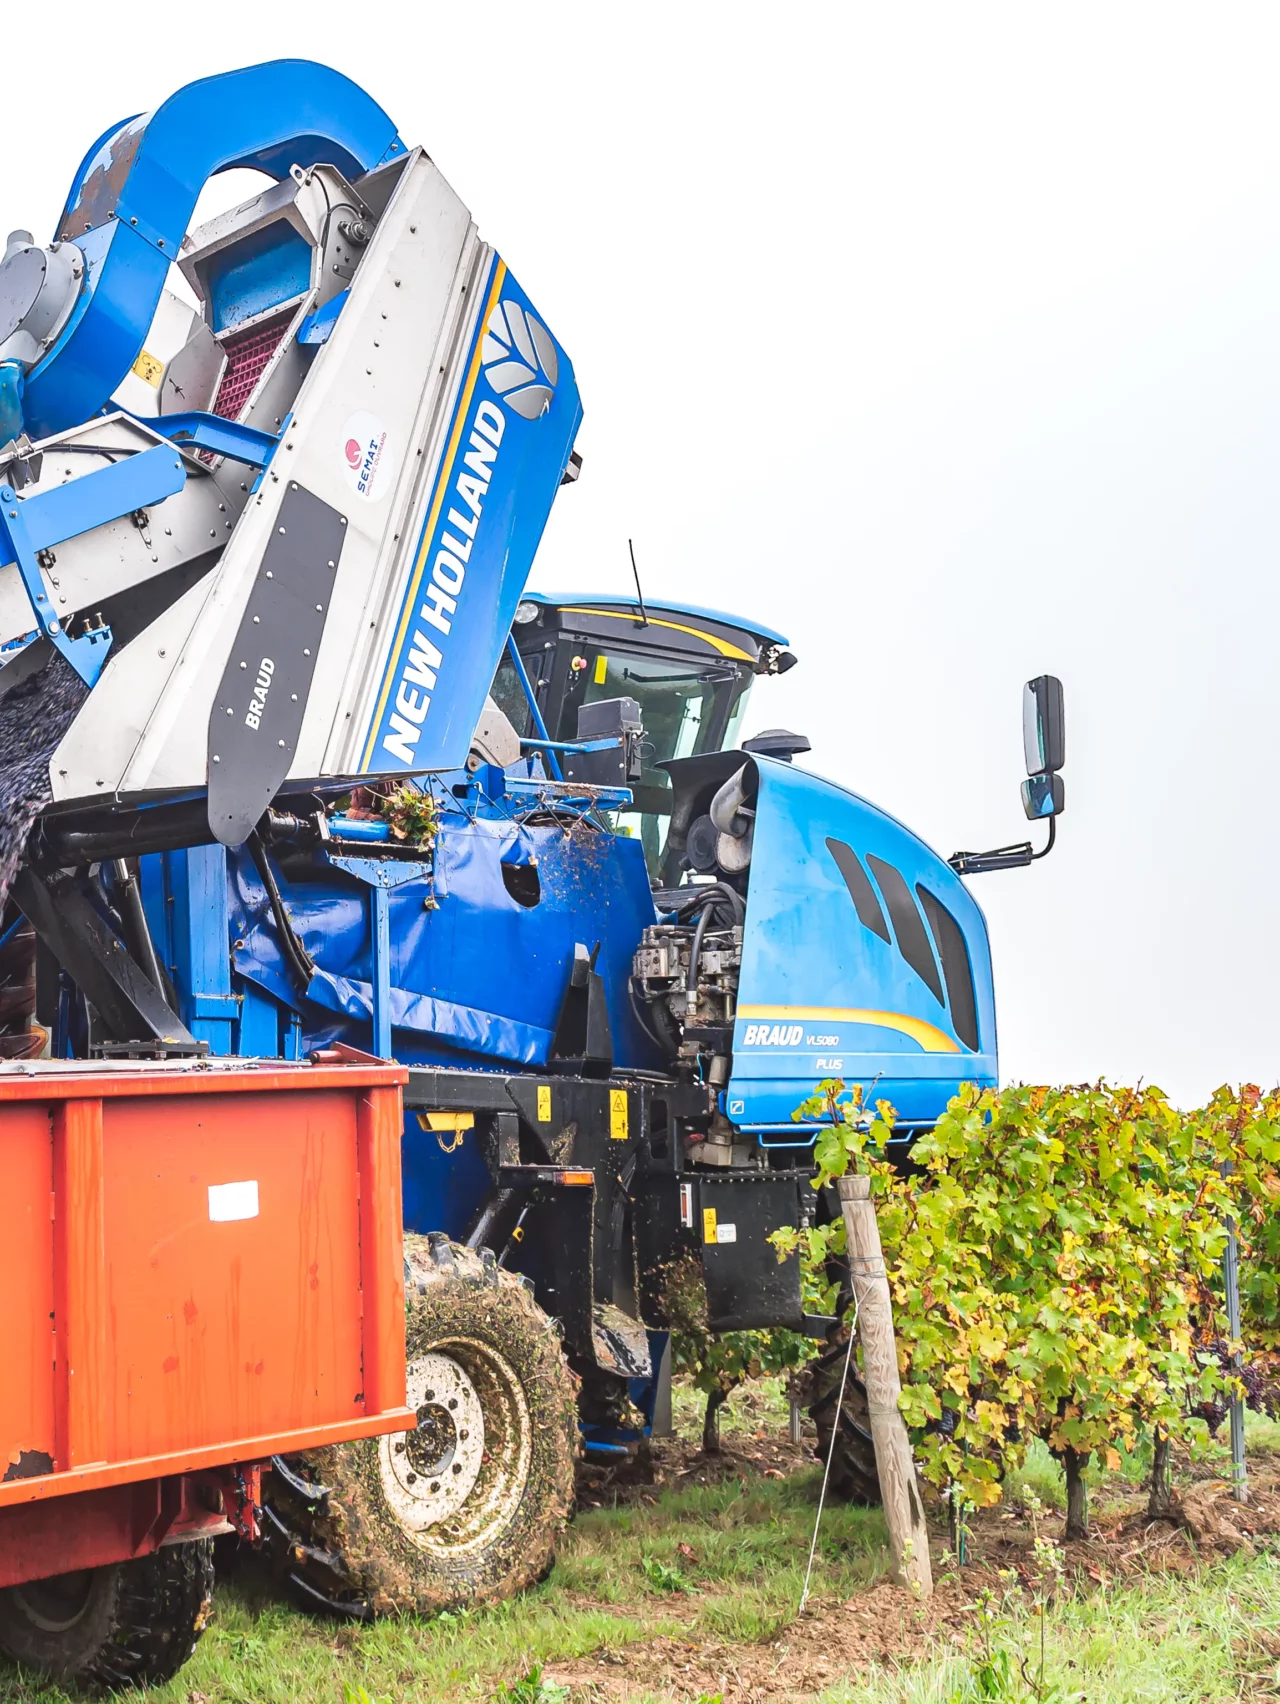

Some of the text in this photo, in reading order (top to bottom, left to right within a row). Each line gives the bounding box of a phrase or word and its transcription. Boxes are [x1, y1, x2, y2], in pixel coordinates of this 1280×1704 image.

[357, 439, 378, 493] SEMAT
[382, 399, 507, 766] NEW HOLLAND
[245, 657, 275, 731] BRAUD
[743, 1024, 804, 1046] BRAUD
[815, 1058, 844, 1070] PLUS
